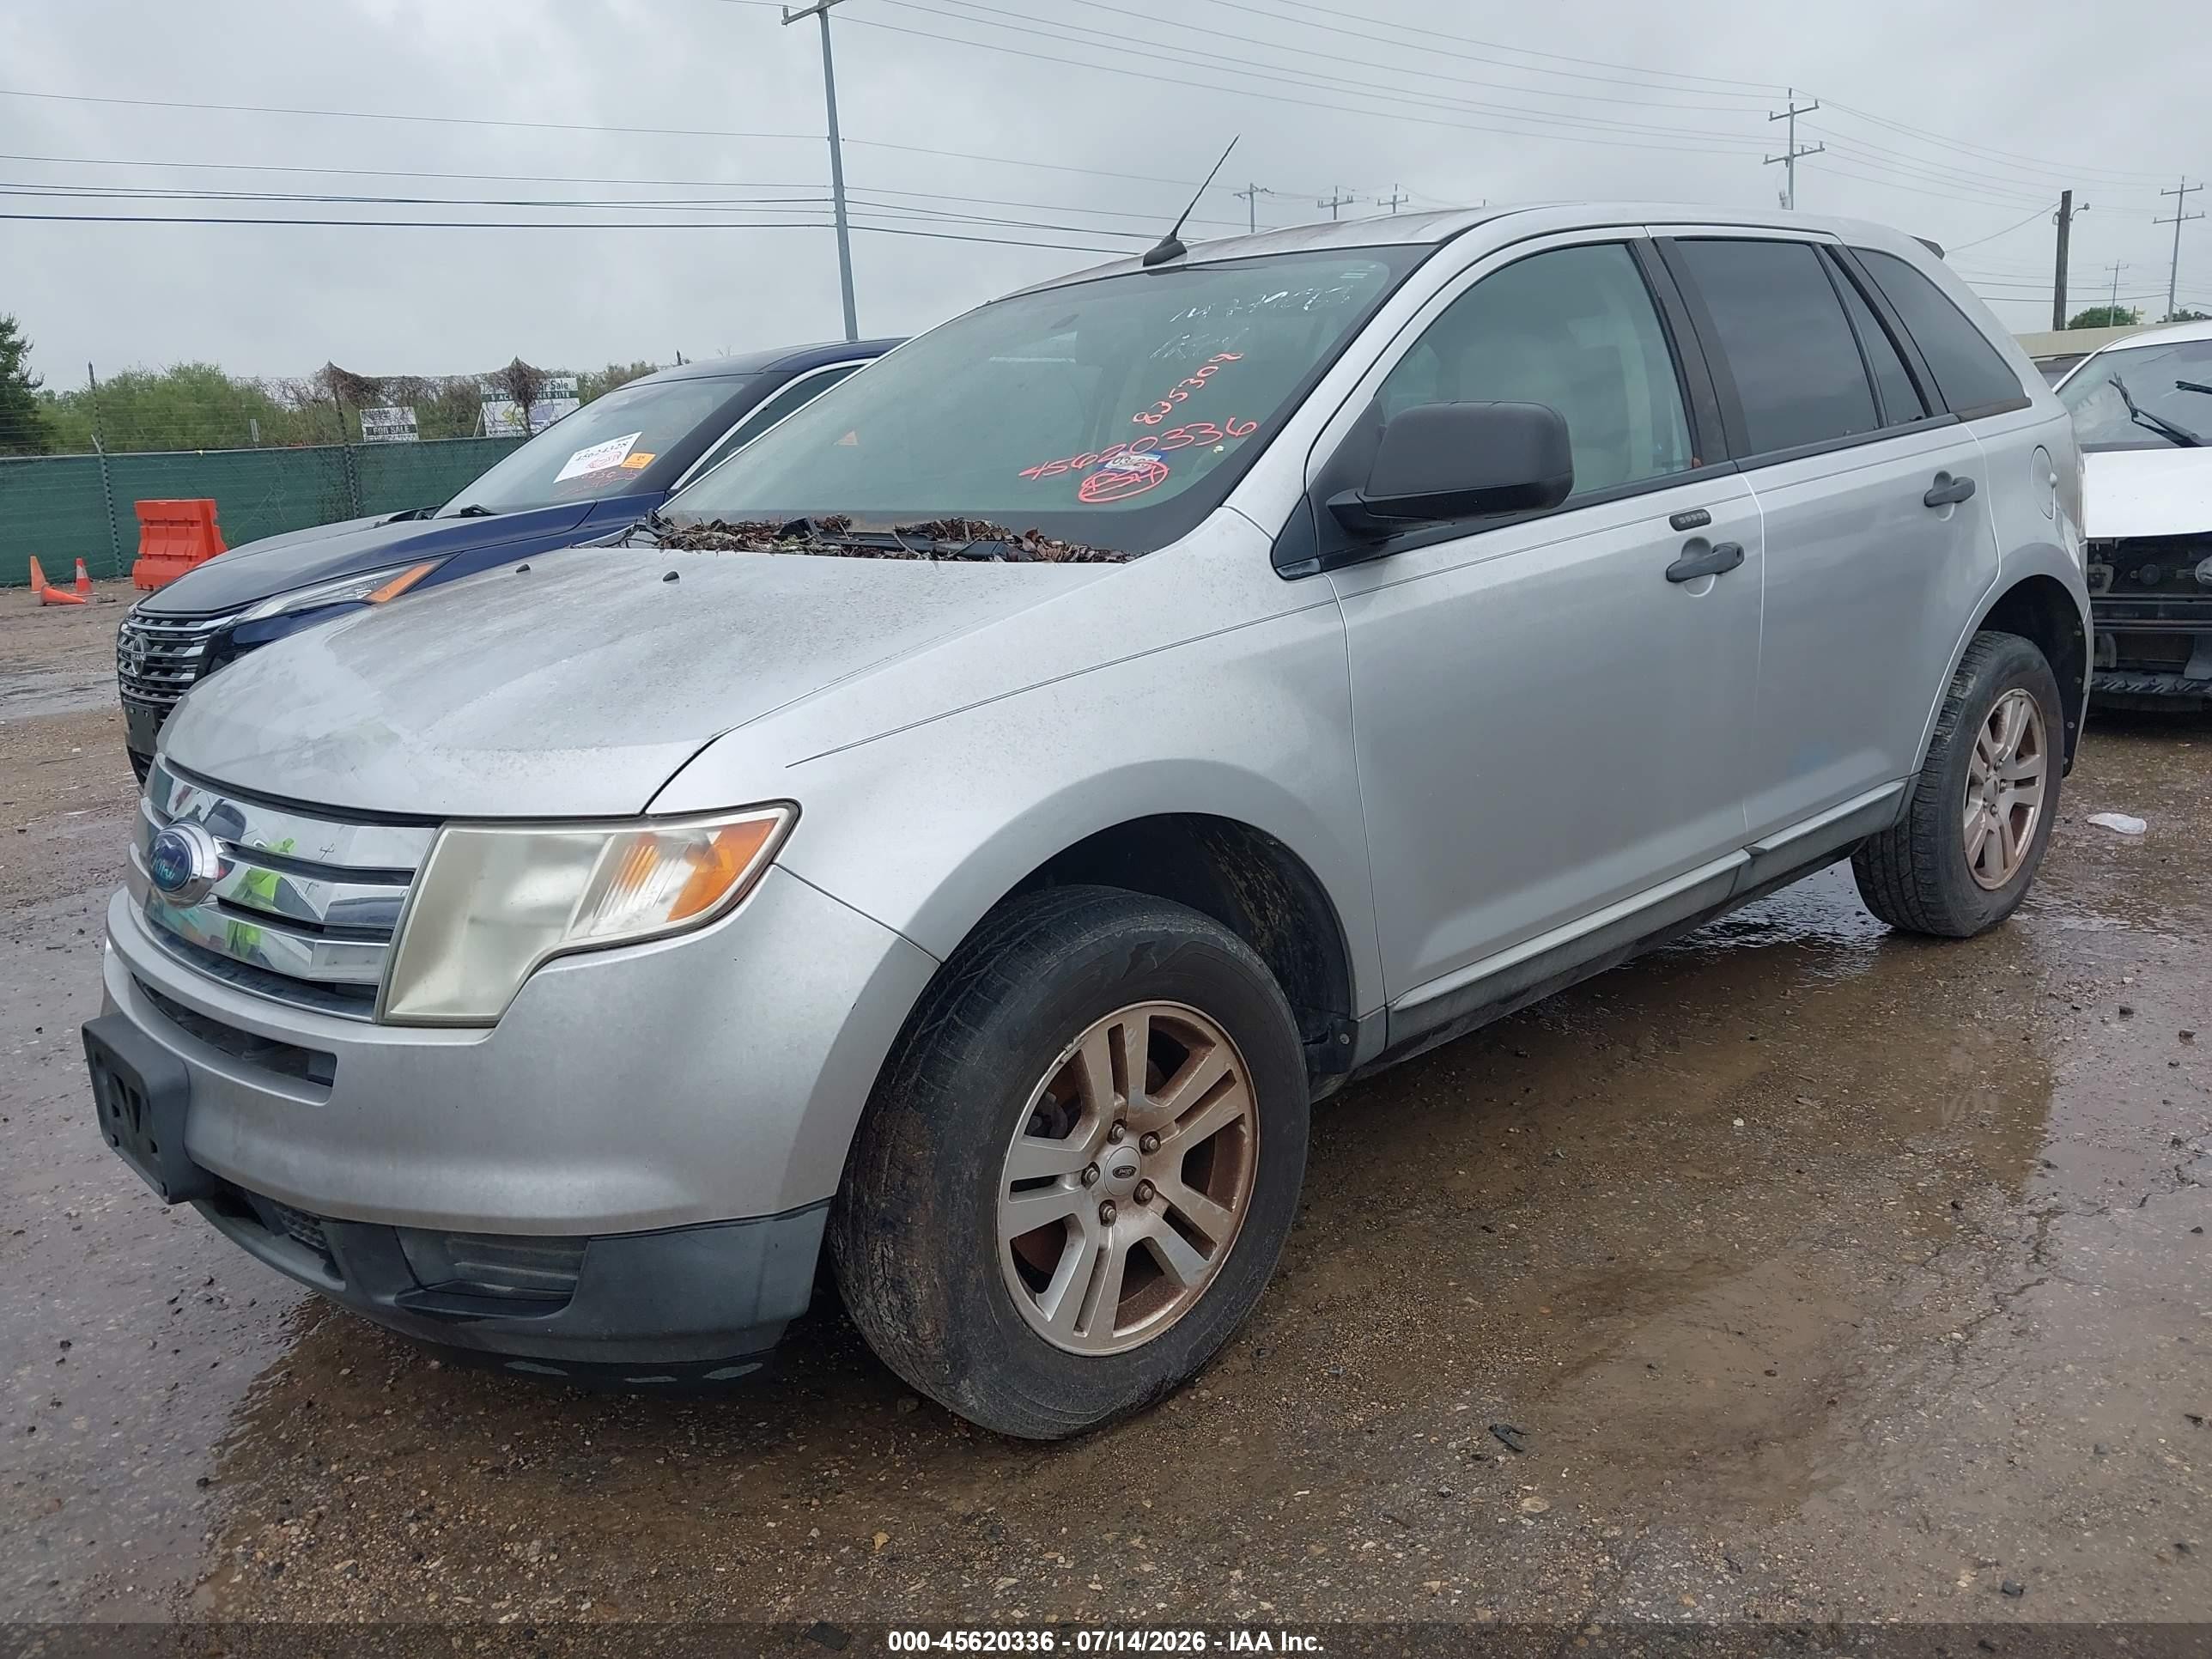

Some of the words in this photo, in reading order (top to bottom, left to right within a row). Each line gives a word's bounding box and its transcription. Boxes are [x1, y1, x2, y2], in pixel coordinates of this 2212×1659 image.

[550, 379, 569, 390] Sale
[391, 425, 410, 434] SALE
[1018, 417, 1258, 481] 45620336
